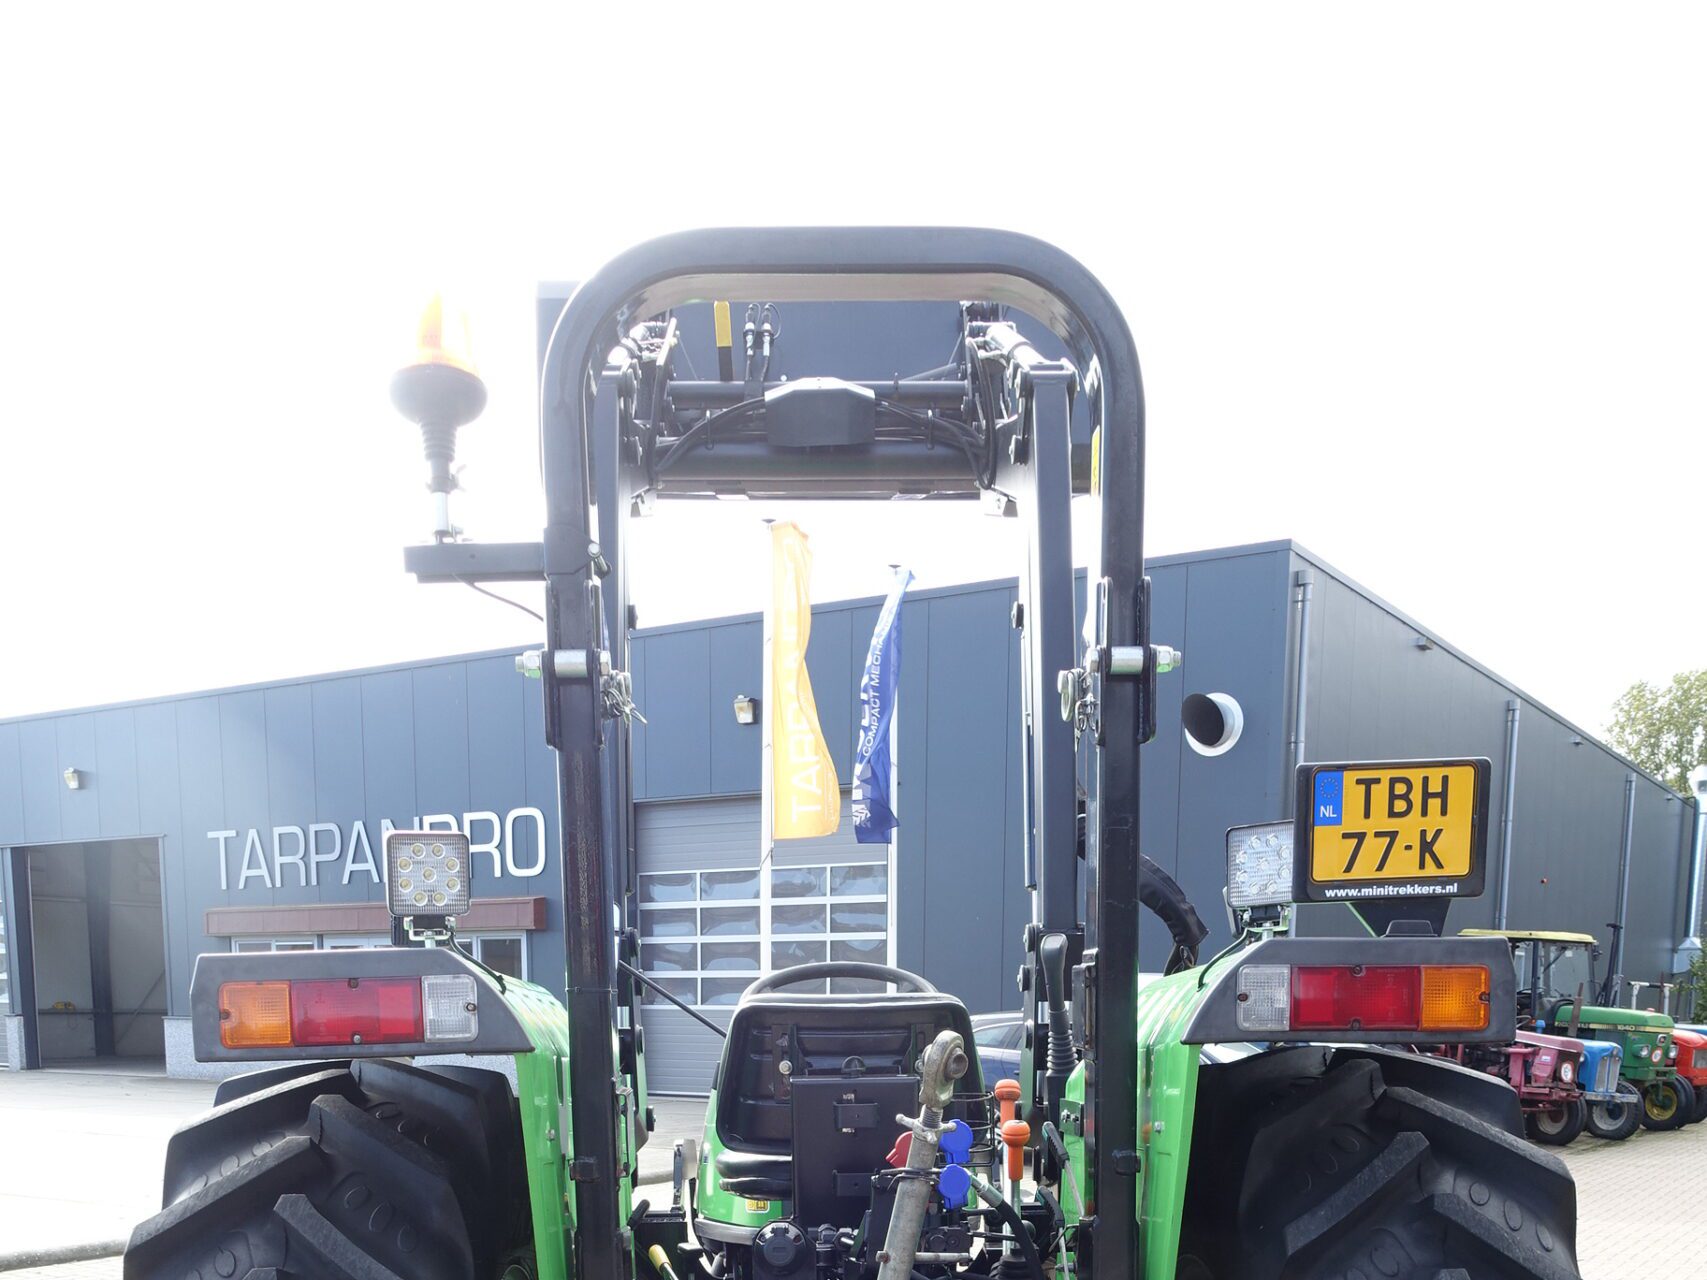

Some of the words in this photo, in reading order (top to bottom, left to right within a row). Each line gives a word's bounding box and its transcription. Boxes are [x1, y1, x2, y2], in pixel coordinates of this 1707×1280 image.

[862, 689, 881, 757] COMPACT
[1320, 805, 1337, 818] NL
[1355, 775, 1449, 819] TBH
[207, 806, 546, 890] TARPARO
[1341, 828, 1445, 874] 77-K
[1325, 883, 1458, 897] www.minitrekkers.nl
